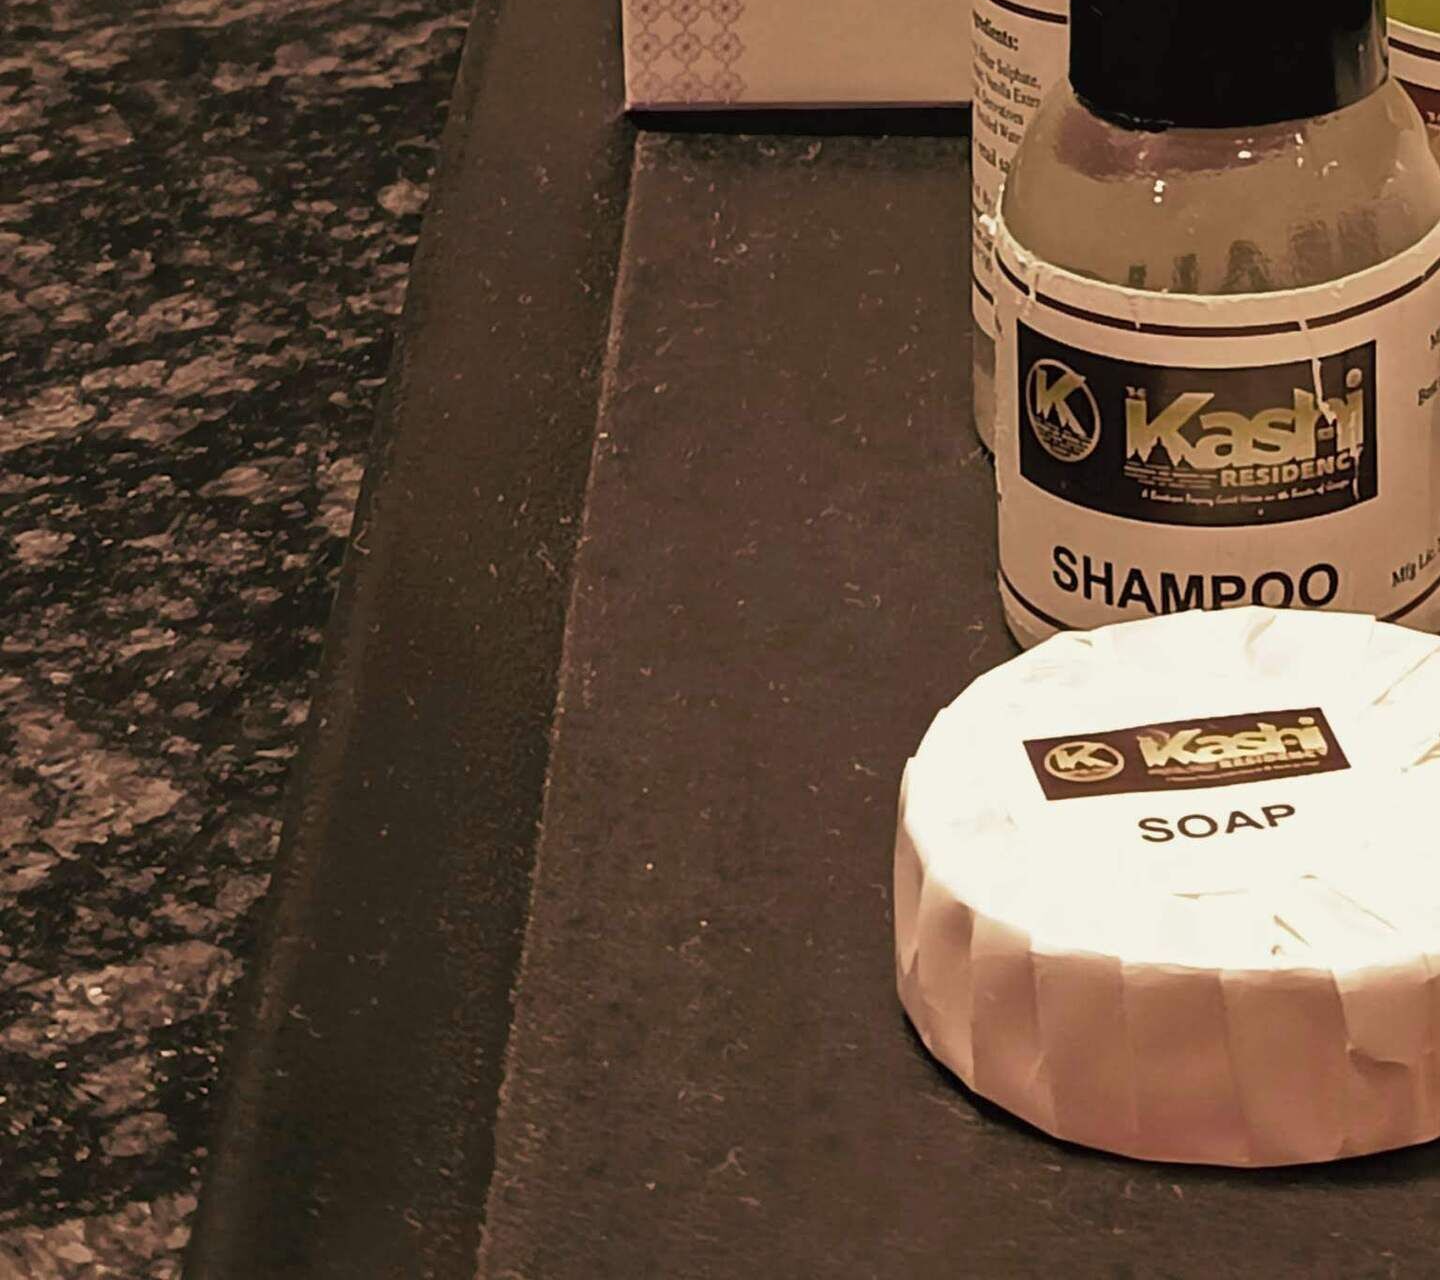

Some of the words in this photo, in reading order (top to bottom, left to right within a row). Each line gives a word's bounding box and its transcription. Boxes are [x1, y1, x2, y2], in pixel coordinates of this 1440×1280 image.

[1052, 545, 1339, 616] SHAMPOO
[1137, 716, 1328, 768] Kashi
[1137, 803, 1296, 842] SOAP
